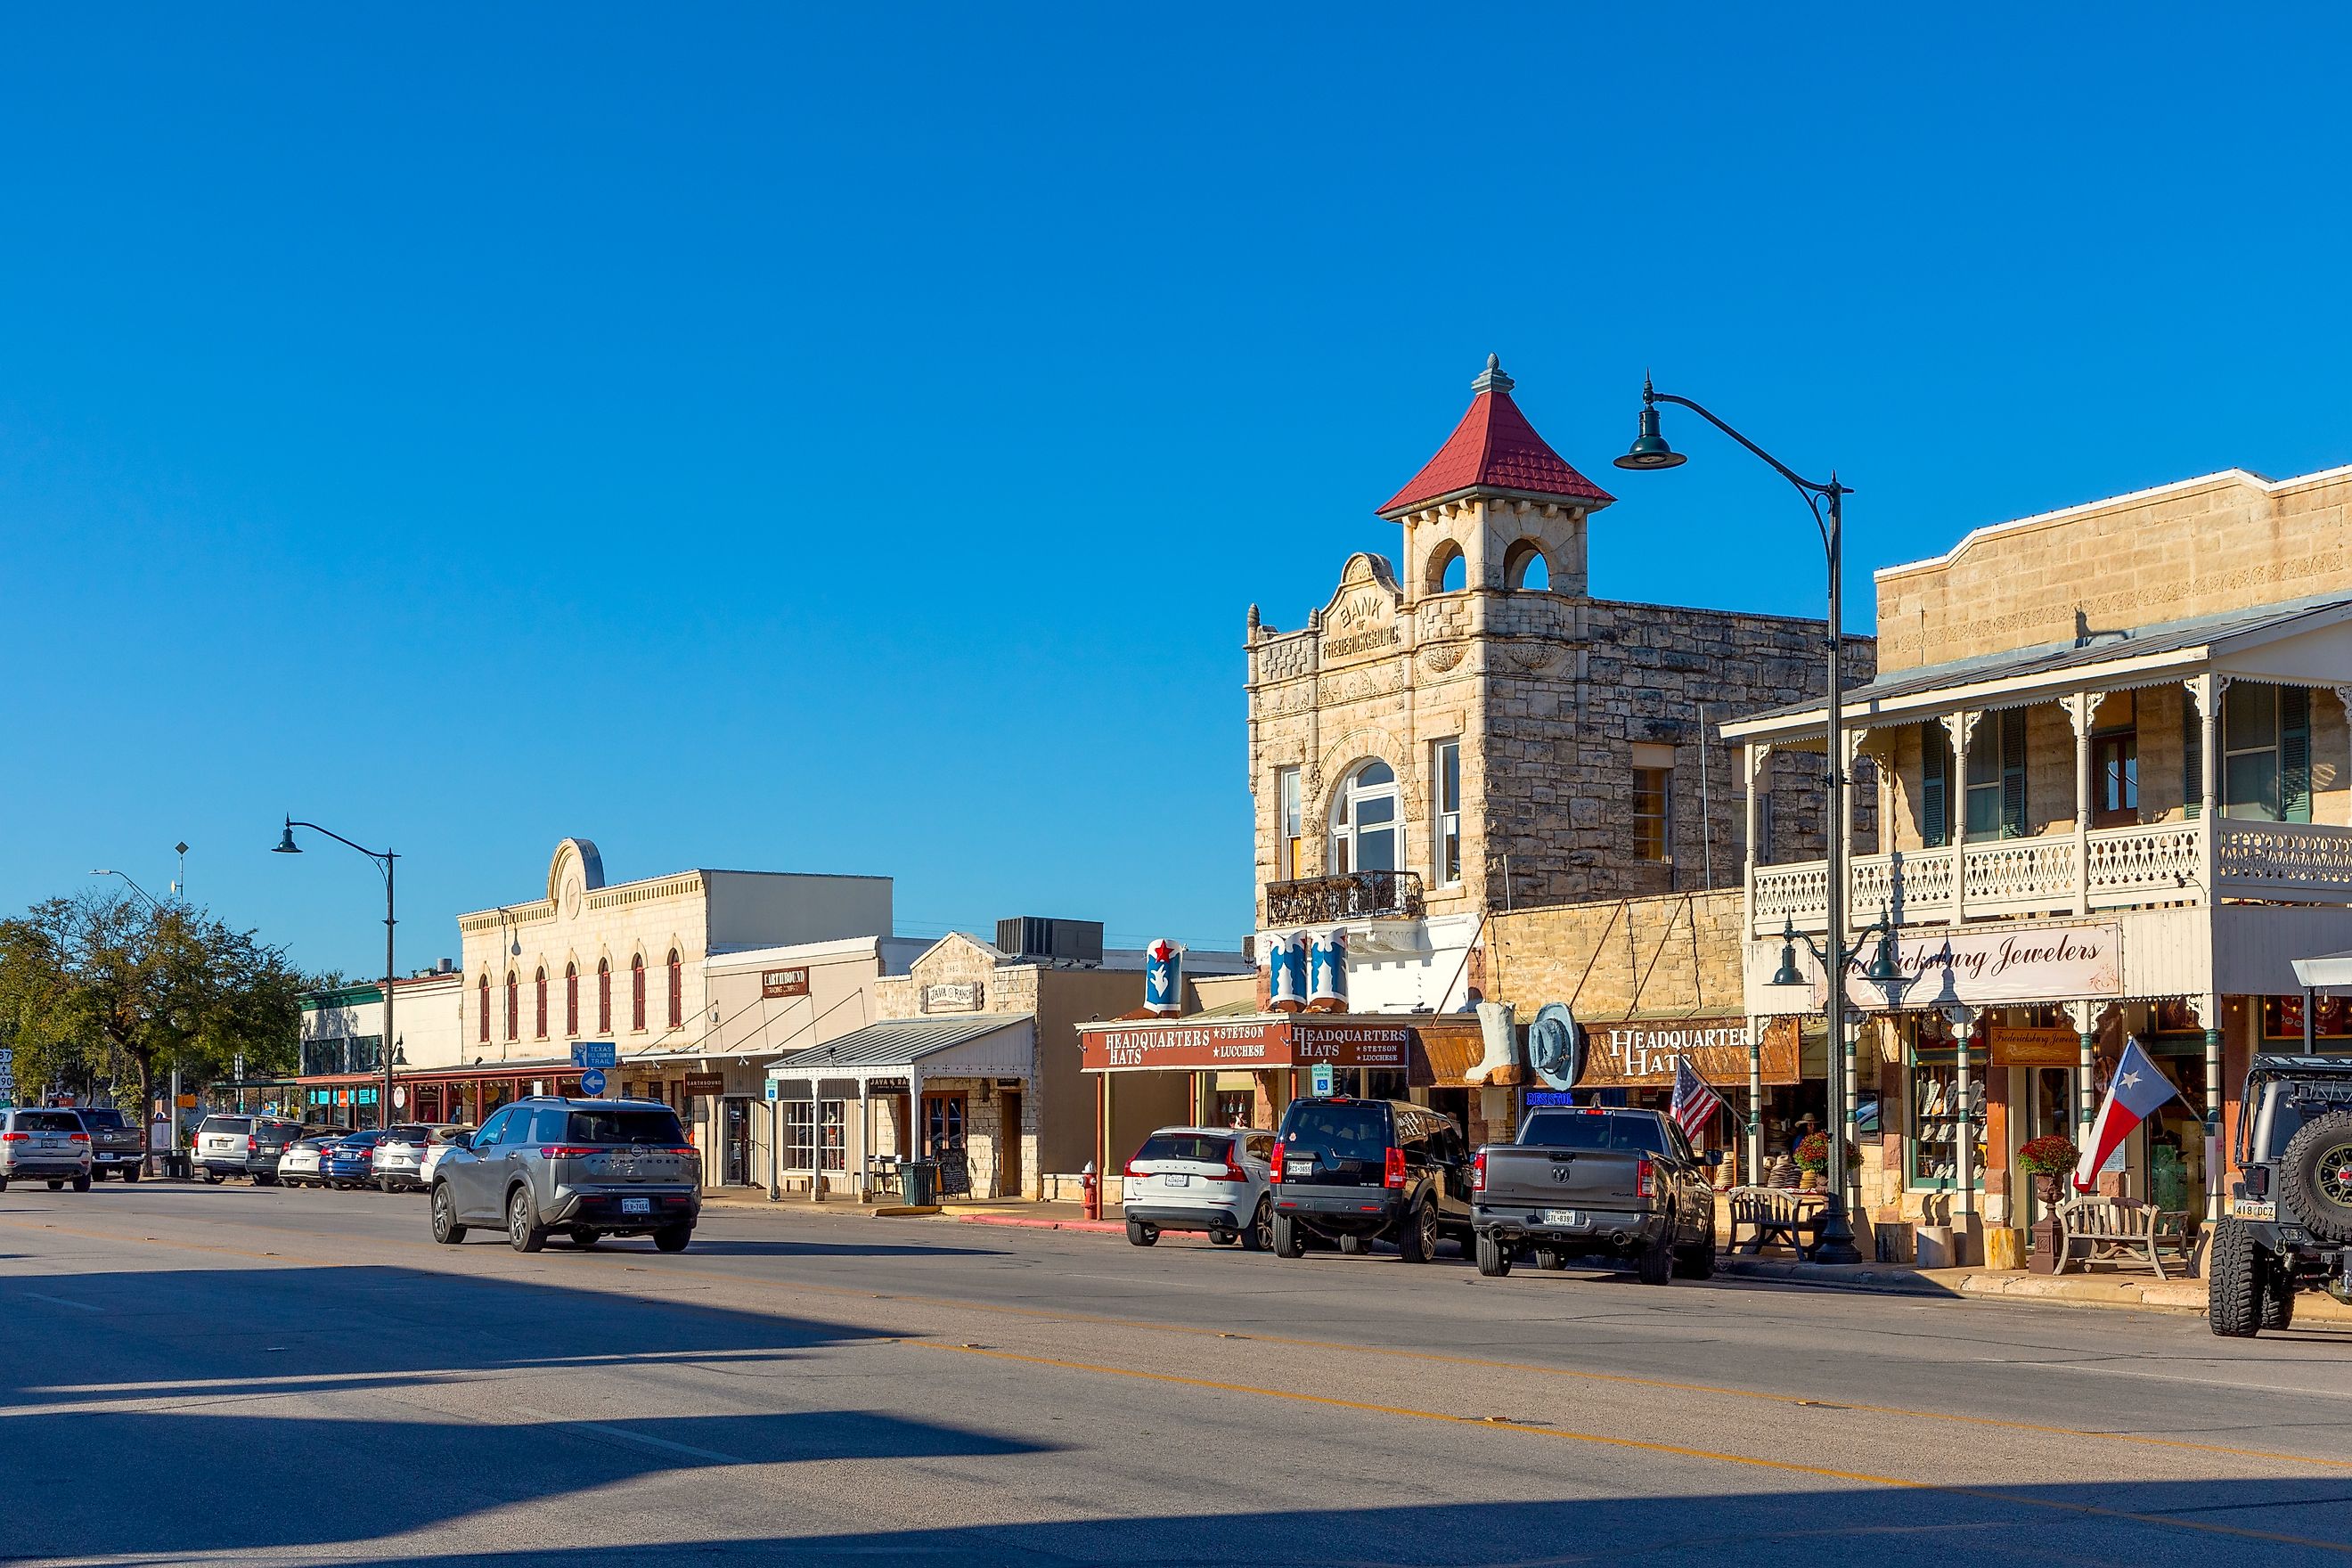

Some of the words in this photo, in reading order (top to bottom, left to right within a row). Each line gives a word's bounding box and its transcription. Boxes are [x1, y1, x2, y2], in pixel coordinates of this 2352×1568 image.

[1341, 596, 1384, 629] BANK
[1357, 619, 1366, 631] OF
[1990, 934, 2104, 977] Jewelers
[764, 969, 805, 986] EARTHBOUND
[930, 987, 947, 1001] JAVA
[954, 988, 974, 1001] RANCH
[1220, 1025, 1265, 1040] STETSON
[1292, 1026, 1407, 1044] HEADQUARTERS
[1105, 1029, 1210, 1052] HEADQUARTERS
[1221, 1045, 1265, 1058] LUCCHESE
[1300, 1041, 1340, 1057] HATS
[1108, 1048, 1142, 1066] HATS
[870, 1078, 888, 1086] JAVA
[1526, 1092, 1573, 1106] RESISTOL
[2236, 1205, 2252, 1215] 418
[2257, 1206, 2274, 1216] DCZ
